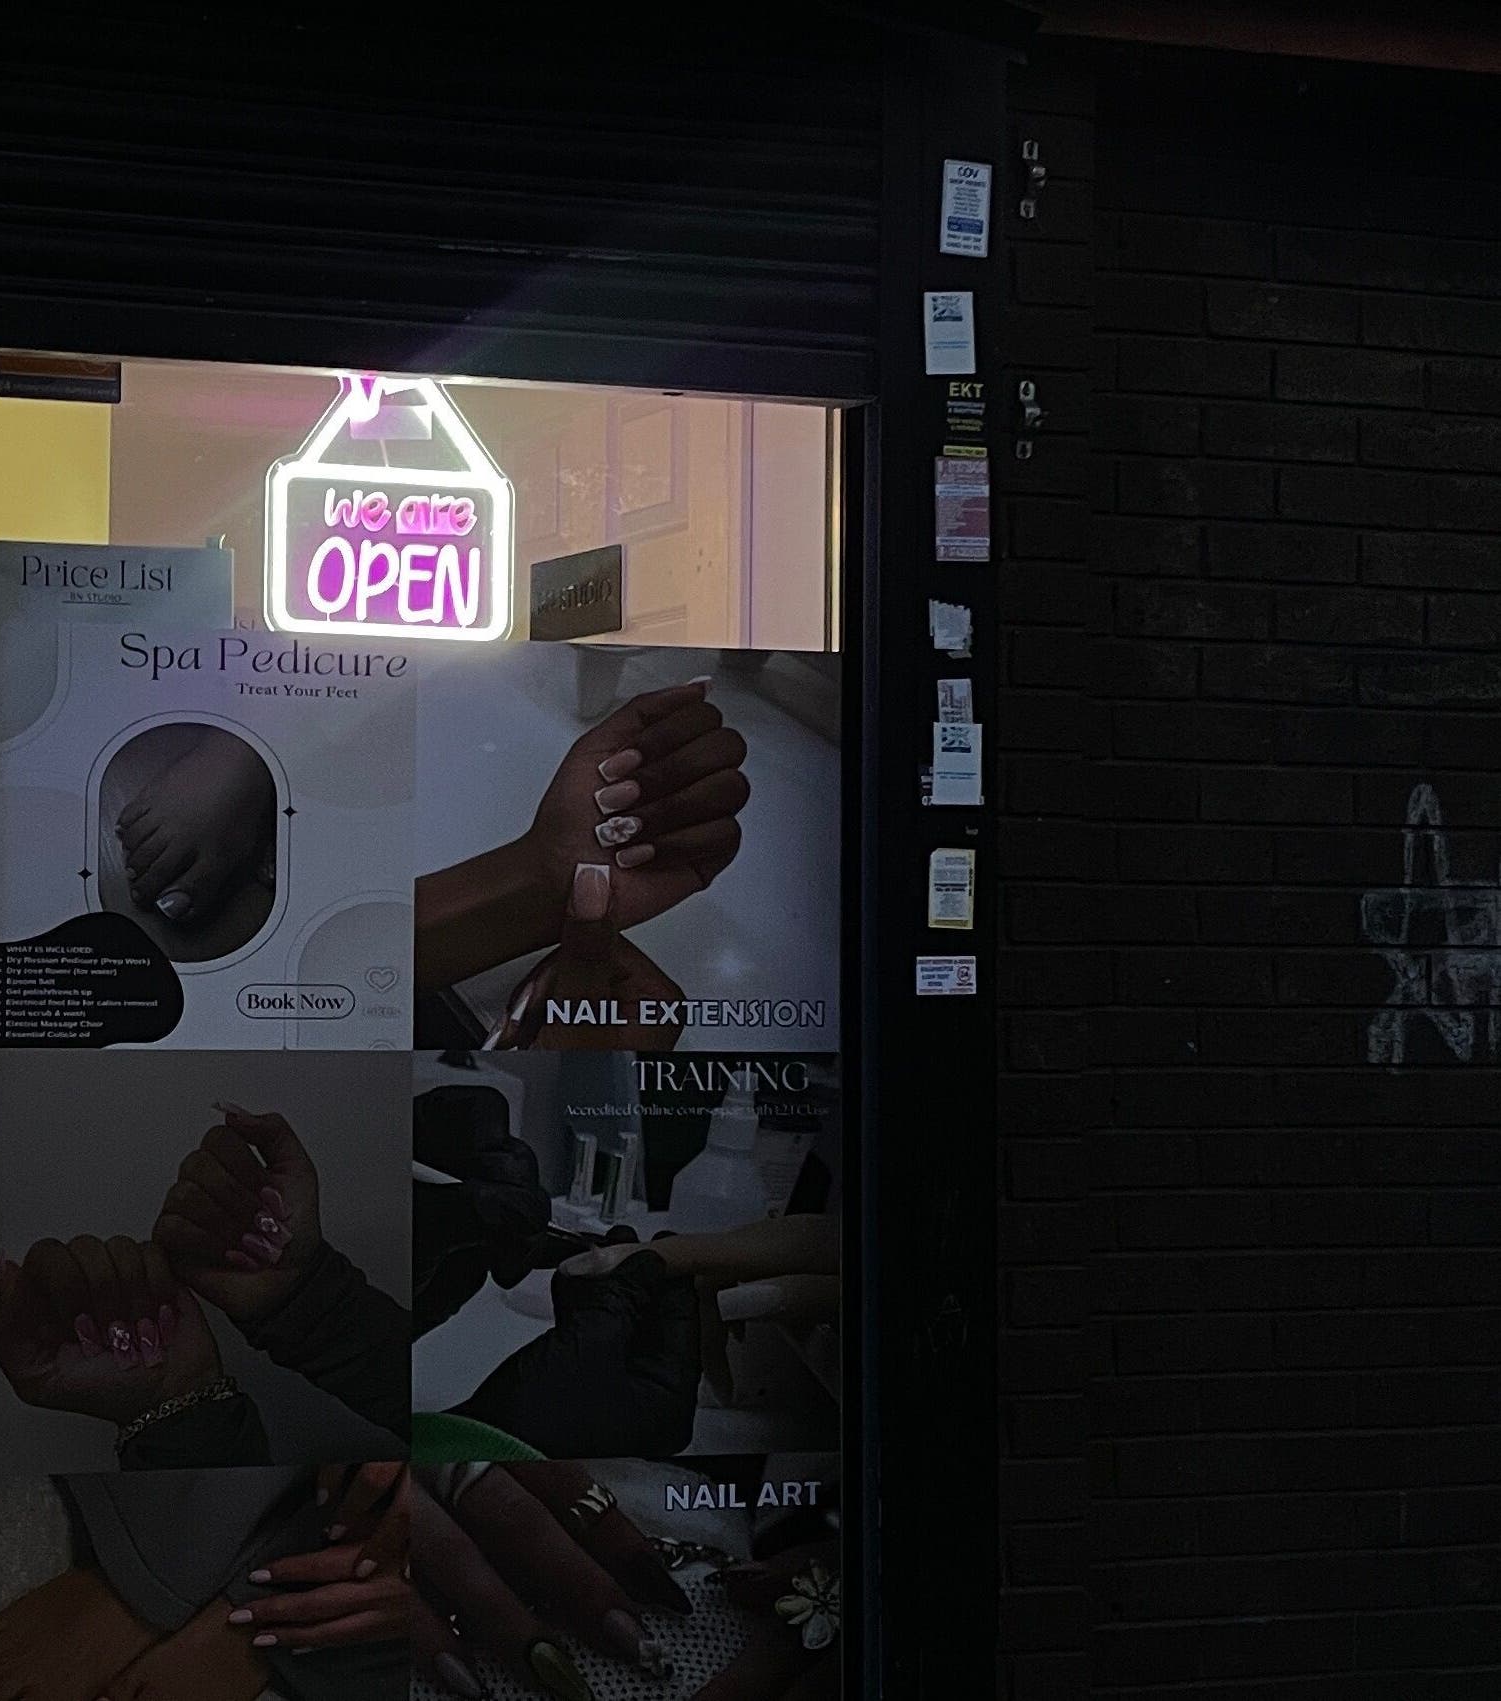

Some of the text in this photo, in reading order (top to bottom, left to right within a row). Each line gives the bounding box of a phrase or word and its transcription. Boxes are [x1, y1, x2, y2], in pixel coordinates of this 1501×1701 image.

[948, 381, 985, 398] EKT
[20, 555, 173, 592] Price List
[307, 535, 481, 627] OPEN
[120, 633, 408, 680] Spa Pedicure
[235, 682, 359, 699] Treat Your Feet
[246, 992, 345, 1011] Book Now
[546, 998, 825, 1027] NAIL EXTENSION
[631, 1060, 810, 1092] TRAINING
[665, 1480, 823, 1511] NAIL ART
